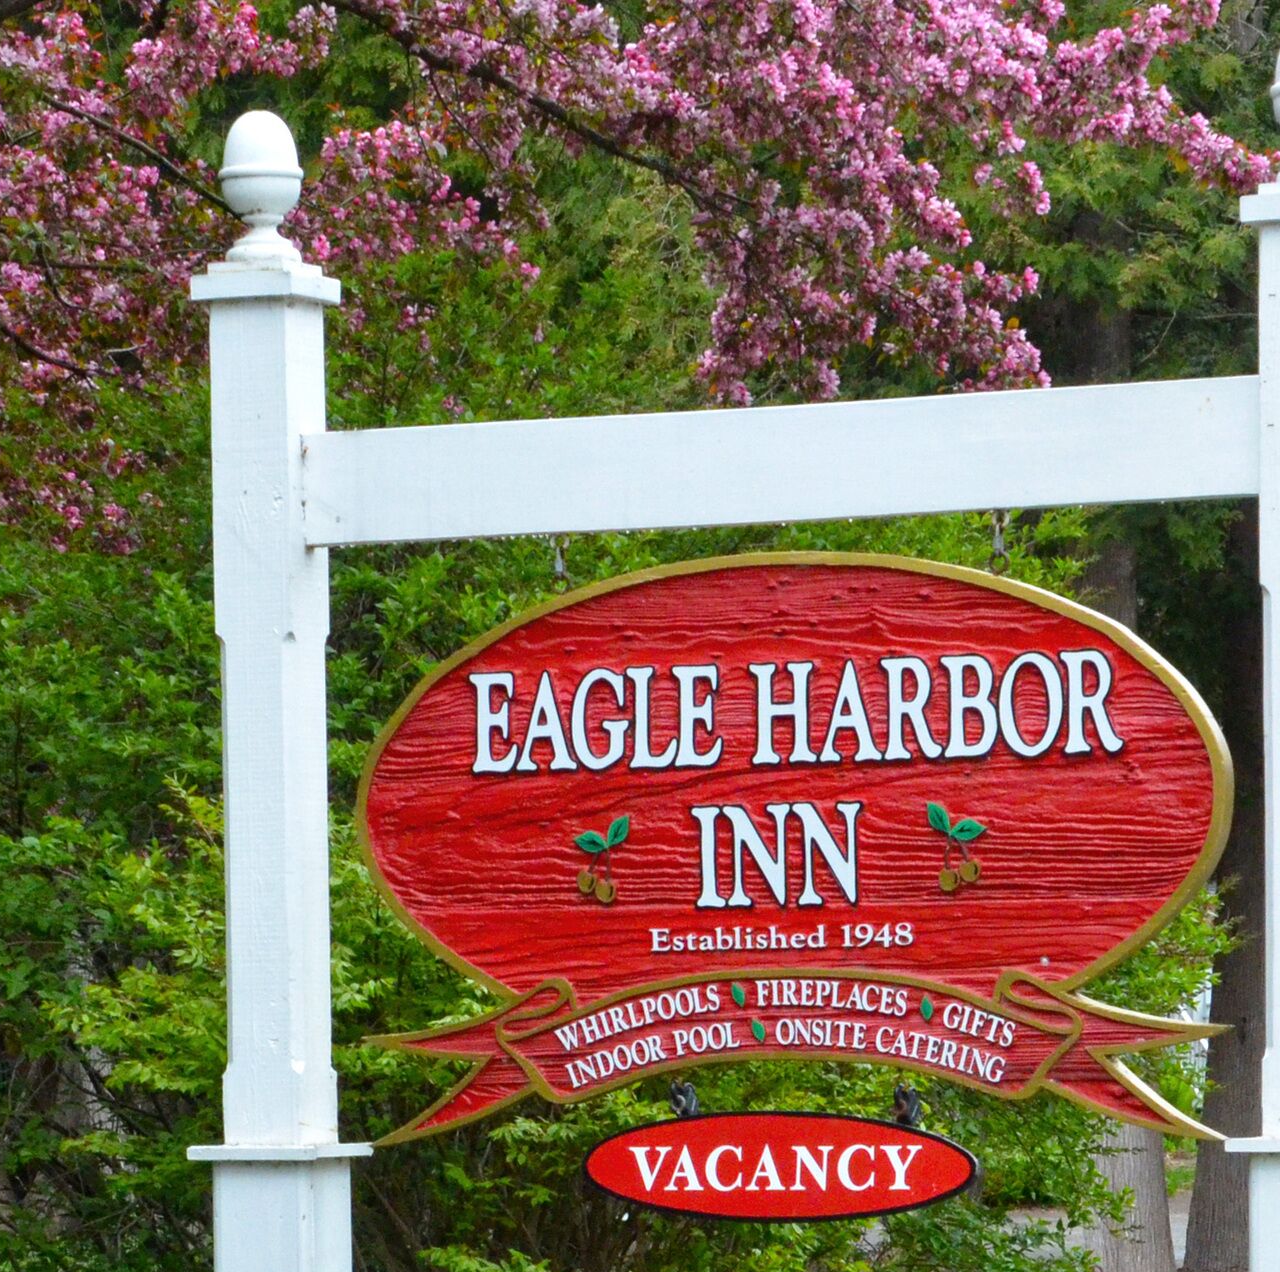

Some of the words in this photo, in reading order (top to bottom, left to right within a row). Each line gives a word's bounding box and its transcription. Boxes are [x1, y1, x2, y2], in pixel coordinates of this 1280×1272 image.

[469, 663, 723, 774] EAGLE
[749, 649, 1123, 765] HARBOR
[690, 802, 861, 908] INN
[649, 924, 826, 951] Established
[841, 922, 914, 948] 1948
[554, 984, 721, 1052] WHIRLPOOLS
[754, 978, 909, 1017] FIREPLACES
[942, 1002, 1016, 1047] GIFTS
[564, 1034, 668, 1089] INDOOR
[672, 1022, 741, 1057] POOL
[775, 1018, 868, 1049] ONSITE
[874, 1025, 1007, 1083] CATERING
[629, 1144, 923, 1193] VACANCY
